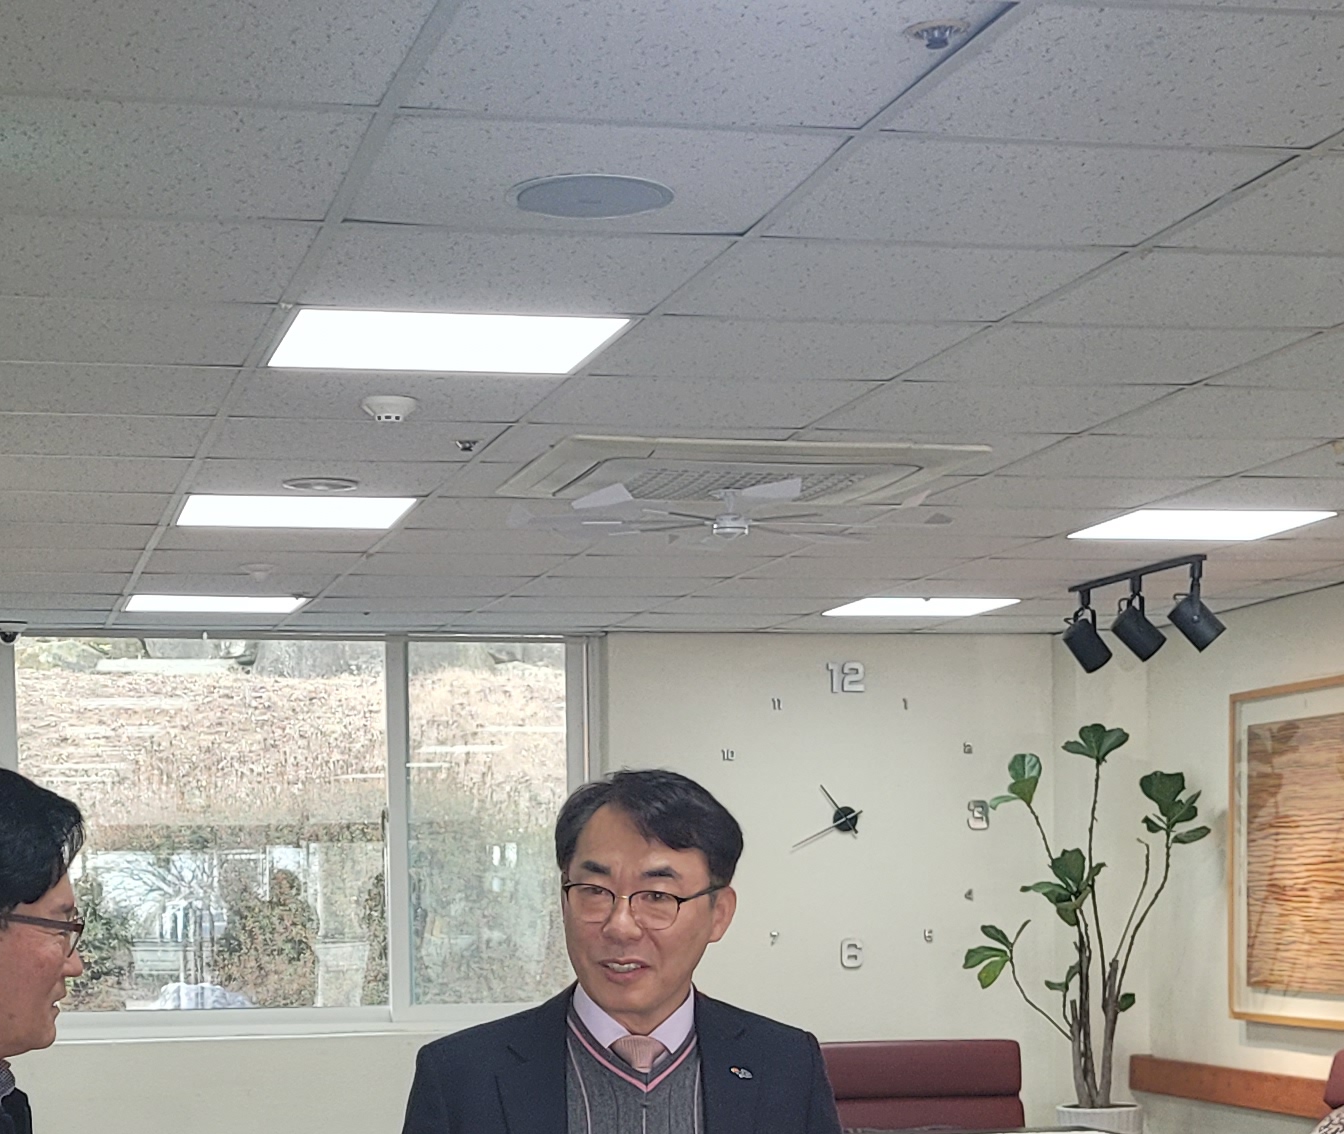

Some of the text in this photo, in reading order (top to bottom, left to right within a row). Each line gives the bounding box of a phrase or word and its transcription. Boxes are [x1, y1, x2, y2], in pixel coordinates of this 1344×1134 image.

[826, 661, 866, 694] 12
[771, 698, 782, 711] 11
[902, 698, 909, 711] 1
[967, 800, 990, 831] 3
[840, 938, 863, 969] 6
